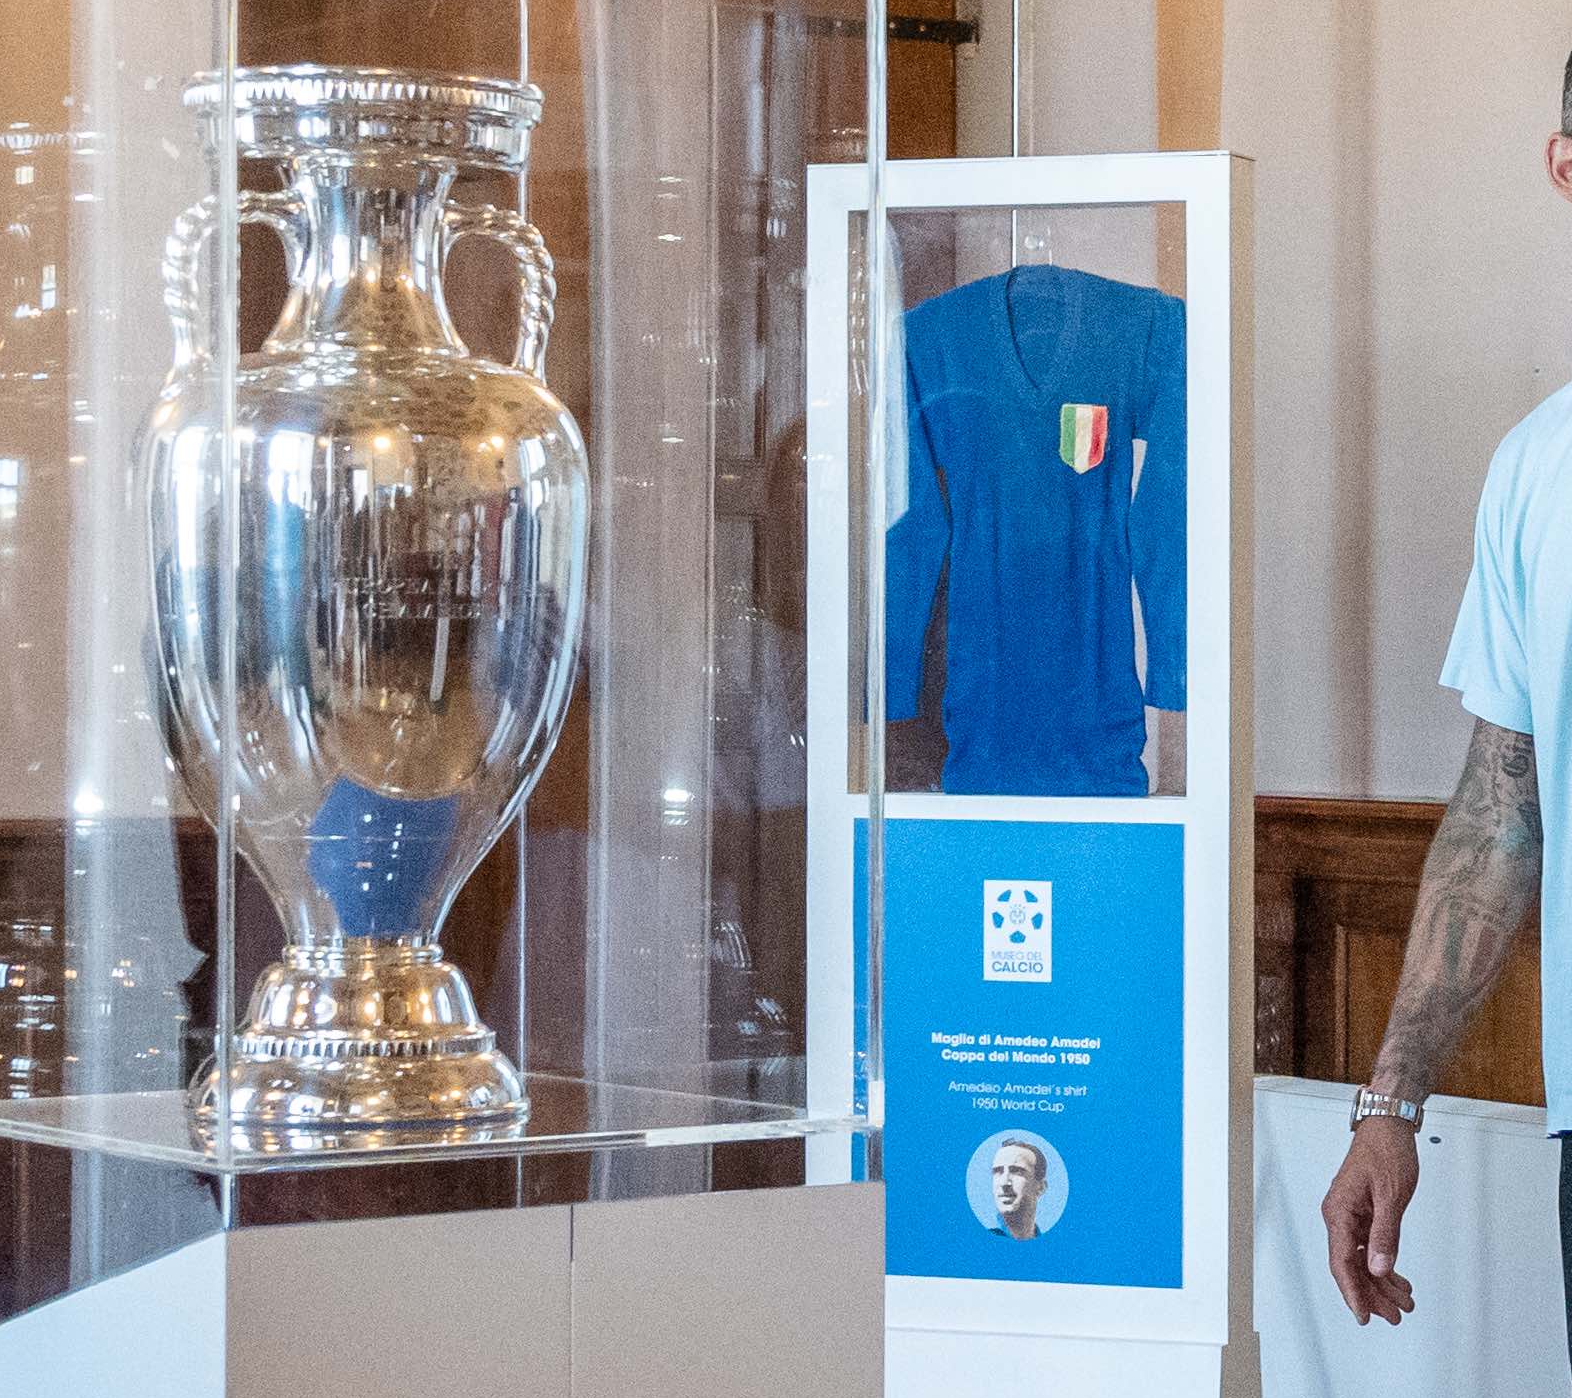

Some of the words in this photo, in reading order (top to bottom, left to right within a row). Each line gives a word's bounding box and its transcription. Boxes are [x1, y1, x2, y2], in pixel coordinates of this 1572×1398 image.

[991, 961, 1044, 973] CALCIO
[931, 1032, 975, 1047] Maglia
[978, 1034, 991, 1046] di
[994, 1034, 1048, 1047] Amedeo
[1050, 1035, 1101, 1049] Amadei
[941, 1049, 985, 1063] Coppa
[988, 1050, 1009, 1062] del
[1012, 1052, 1056, 1064] Mondo
[1059, 1053, 1091, 1065] 1950
[948, 1081, 1001, 1094] Amedeo
[1063, 1084, 1088, 1096] shirt
[971, 1097, 998, 1110] 1950
[1000, 1098, 1036, 1111] World
[1038, 1100, 1065, 1113] Cup
